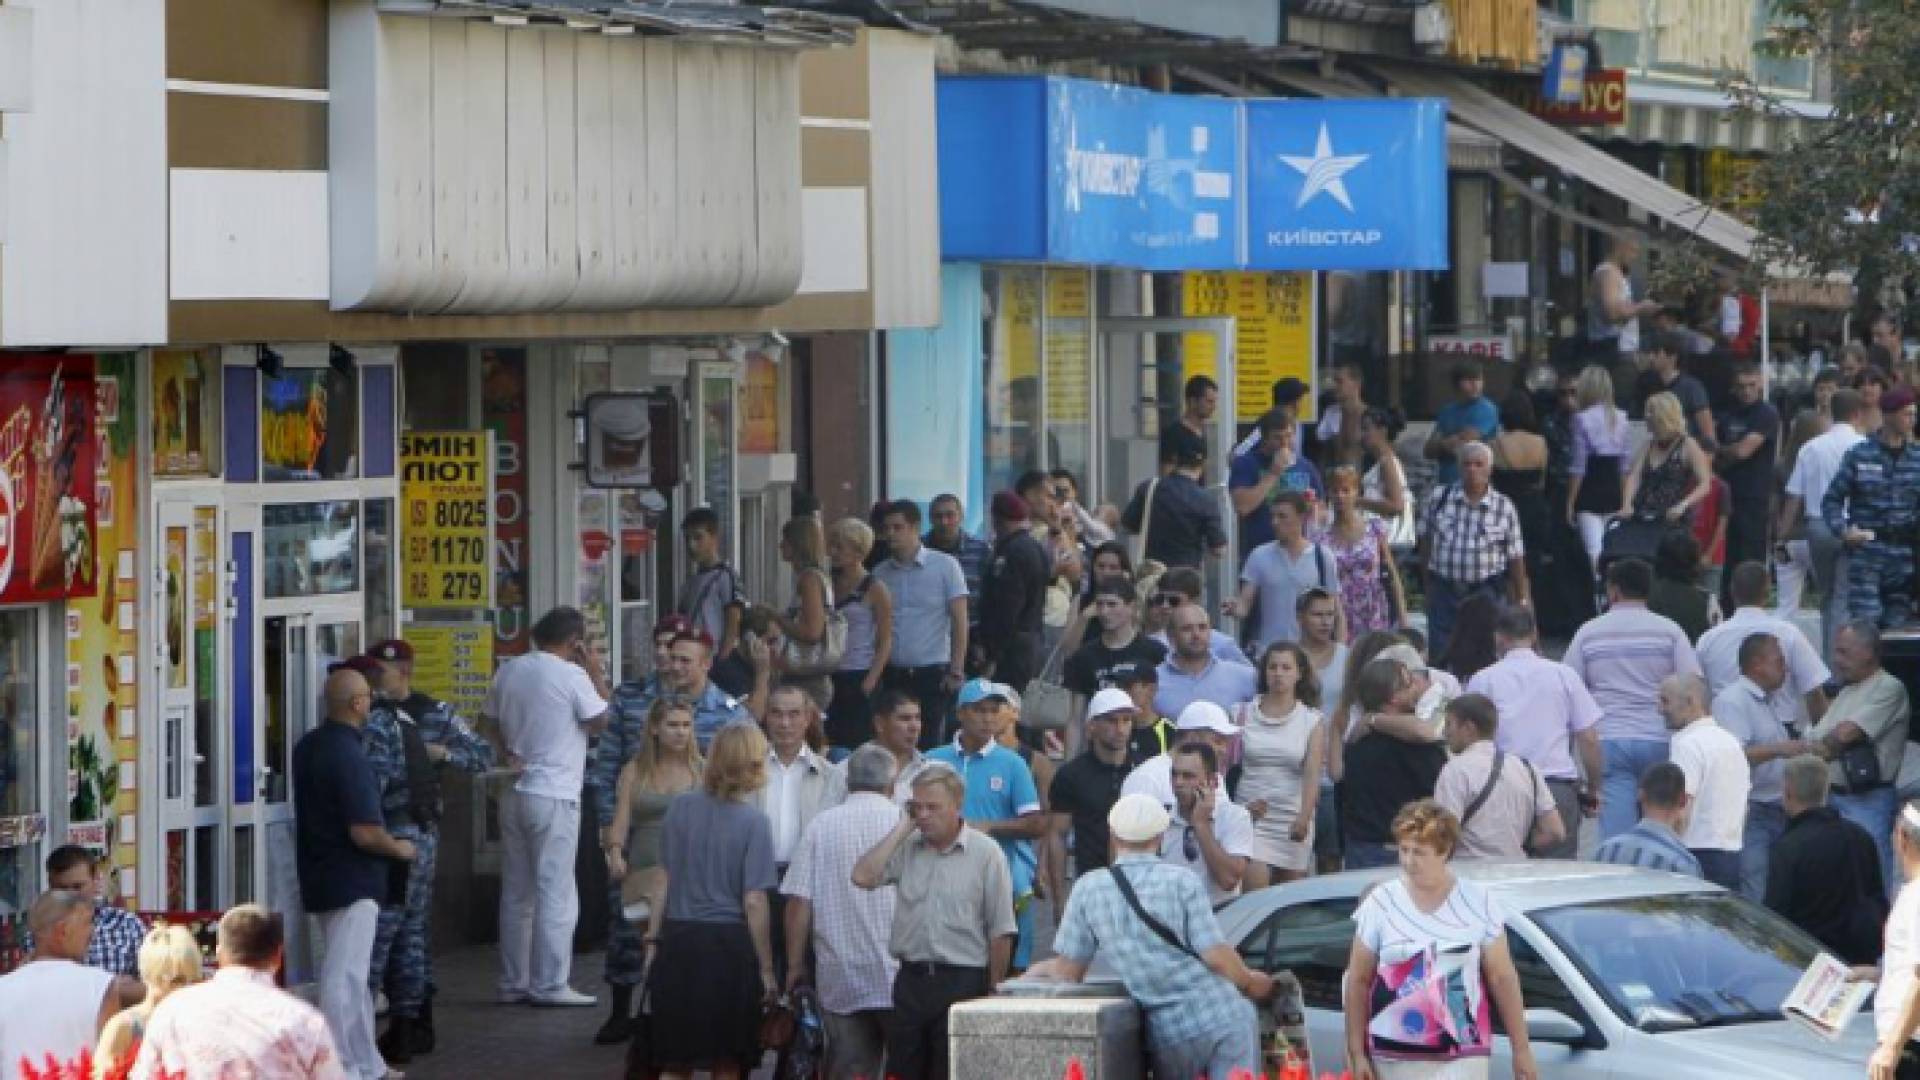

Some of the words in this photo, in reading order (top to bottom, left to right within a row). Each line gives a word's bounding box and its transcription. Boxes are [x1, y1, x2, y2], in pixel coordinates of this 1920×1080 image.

[1267, 226, 1382, 247] КИЇВСТАР
[435, 500, 487, 528] 8025
[431, 537, 484, 565] 1170
[442, 572, 481, 600] 279
